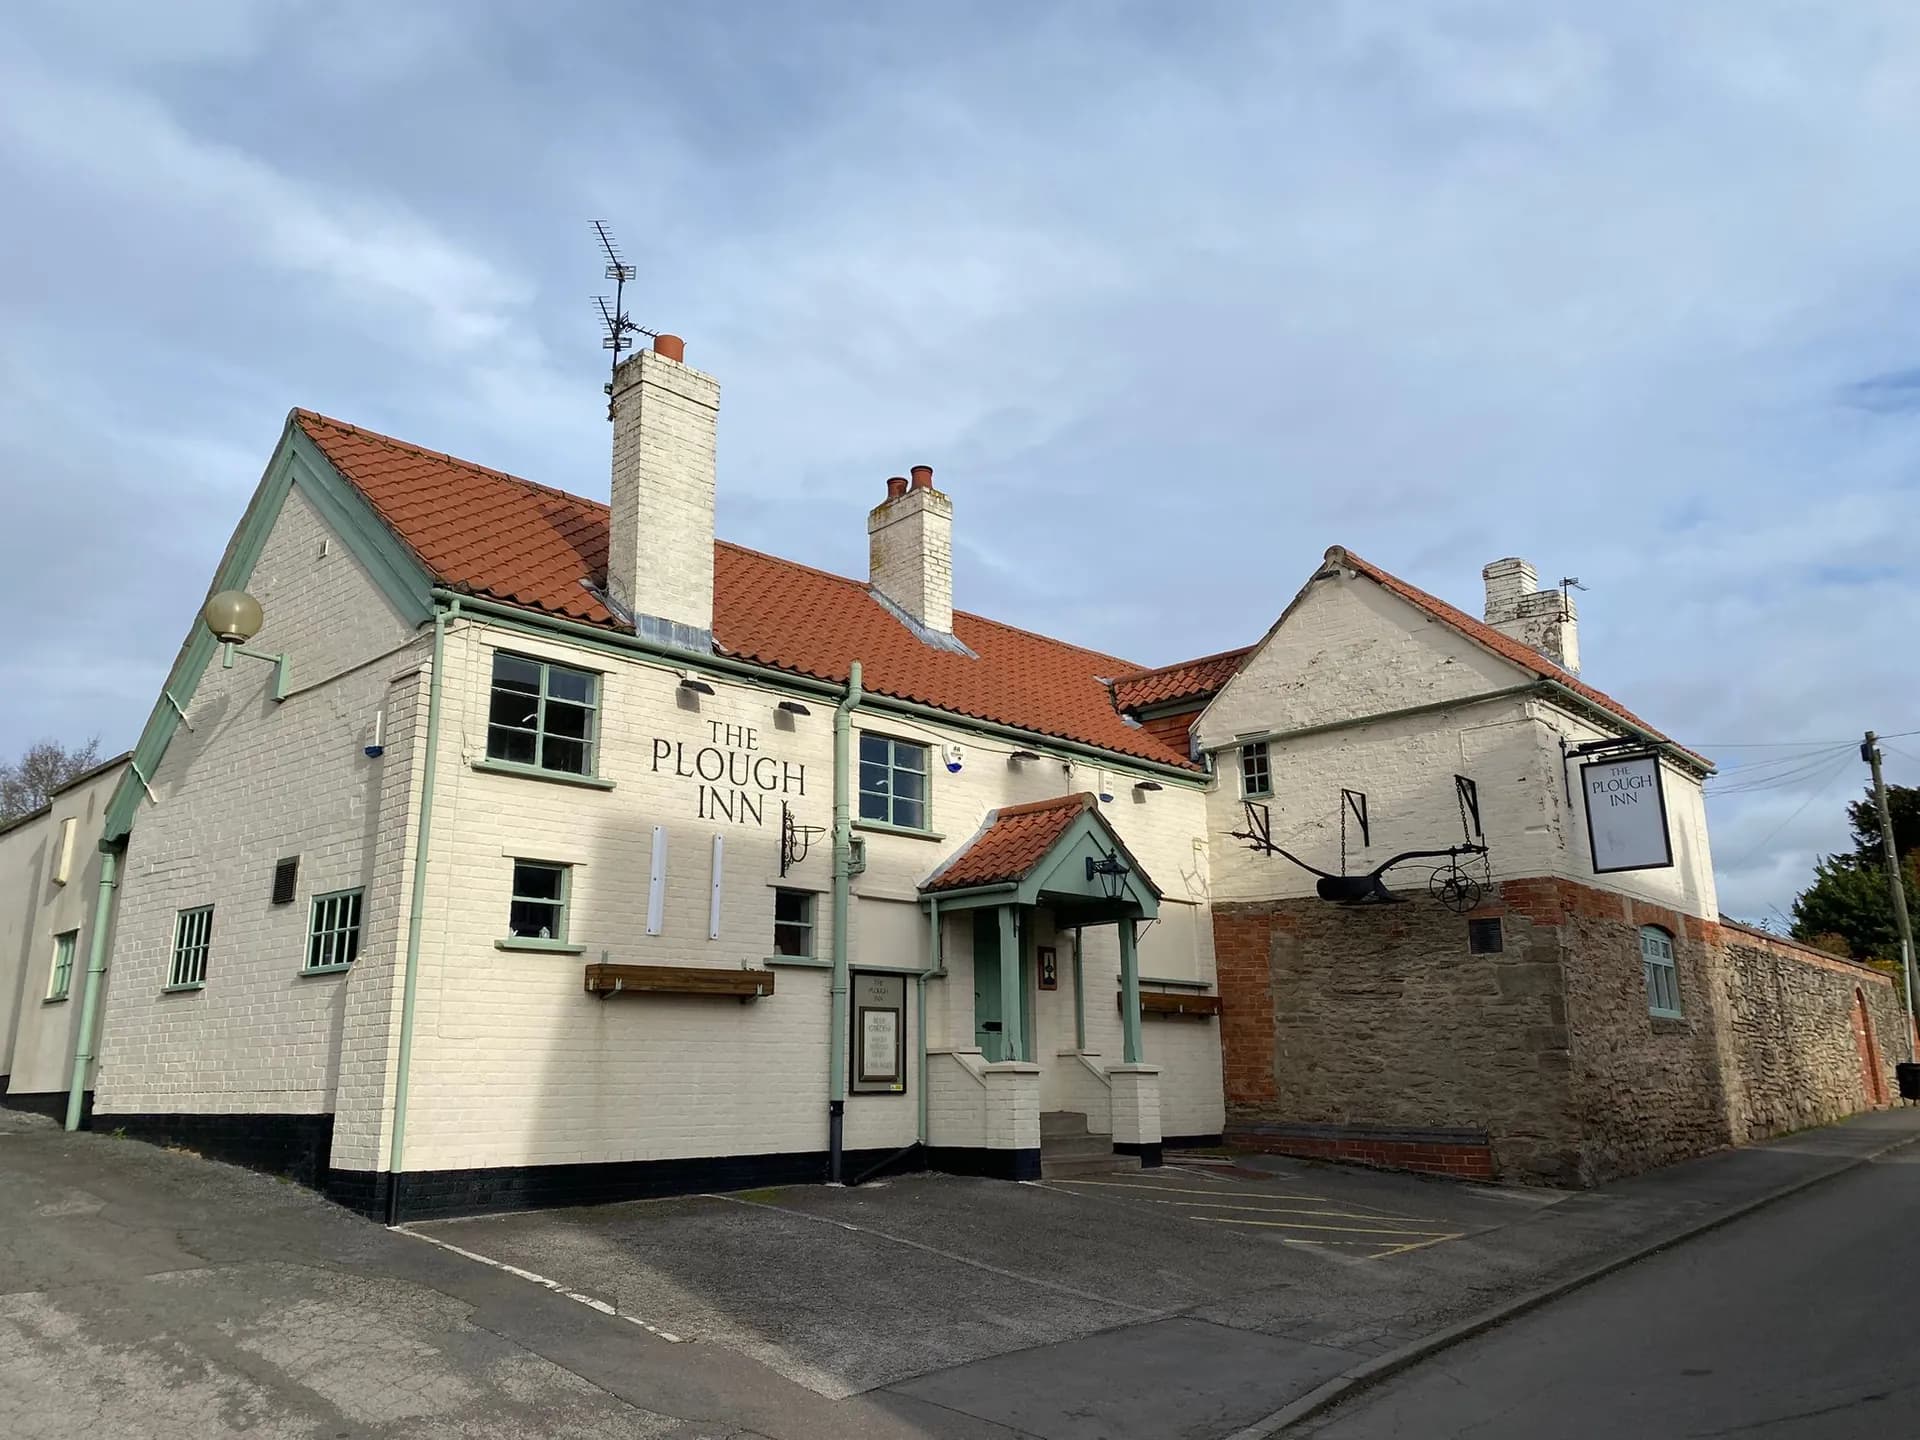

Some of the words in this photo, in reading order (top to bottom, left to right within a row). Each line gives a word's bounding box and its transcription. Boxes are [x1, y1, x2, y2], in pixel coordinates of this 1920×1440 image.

[707, 719, 759, 751] THE
[651, 738, 805, 796] PLOUGH
[1610, 767, 1630, 776] THE
[1592, 775, 1652, 793] PLOUGH
[698, 785, 763, 826] INN
[1610, 792, 1637, 806] INN
